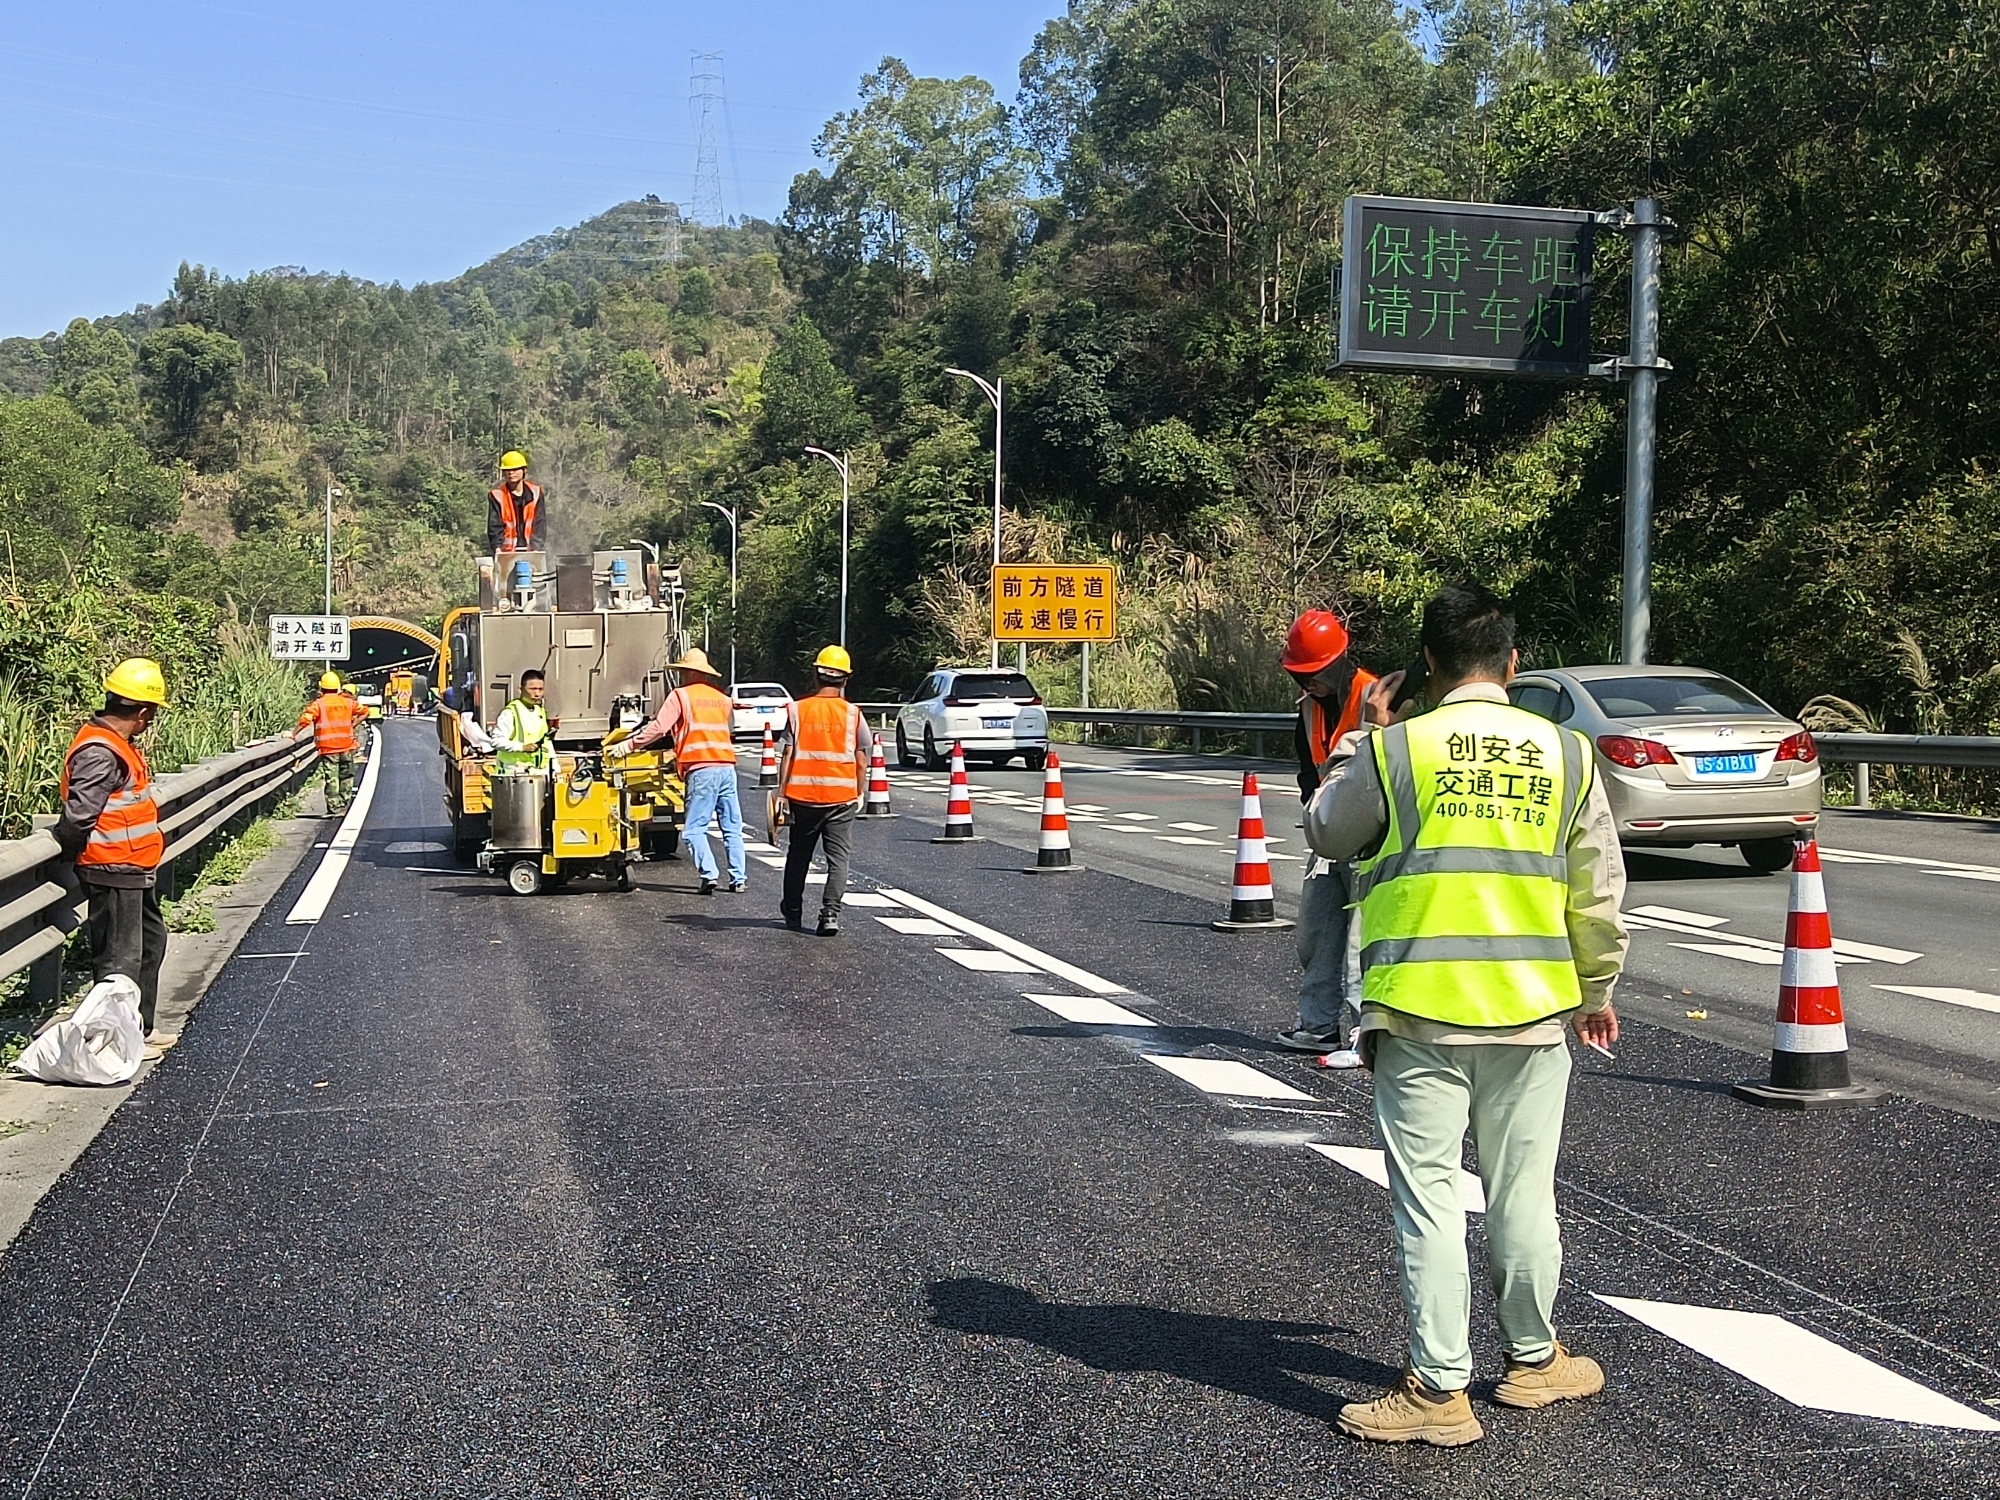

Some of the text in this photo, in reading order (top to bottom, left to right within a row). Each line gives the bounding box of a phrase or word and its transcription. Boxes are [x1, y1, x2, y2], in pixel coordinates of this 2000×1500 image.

[1364, 222, 1580, 287] 保持车距
[1362, 284, 1578, 348] 请开车灯
[1002, 575, 1104, 598] 前方隧道
[276, 621, 344, 635] 进入隧道
[1002, 608, 1104, 631] 减速慢行
[275, 640, 344, 653] 请开车灯
[1445, 732, 1544, 769] 创安全
[1435, 767, 1552, 806] 交通工程
